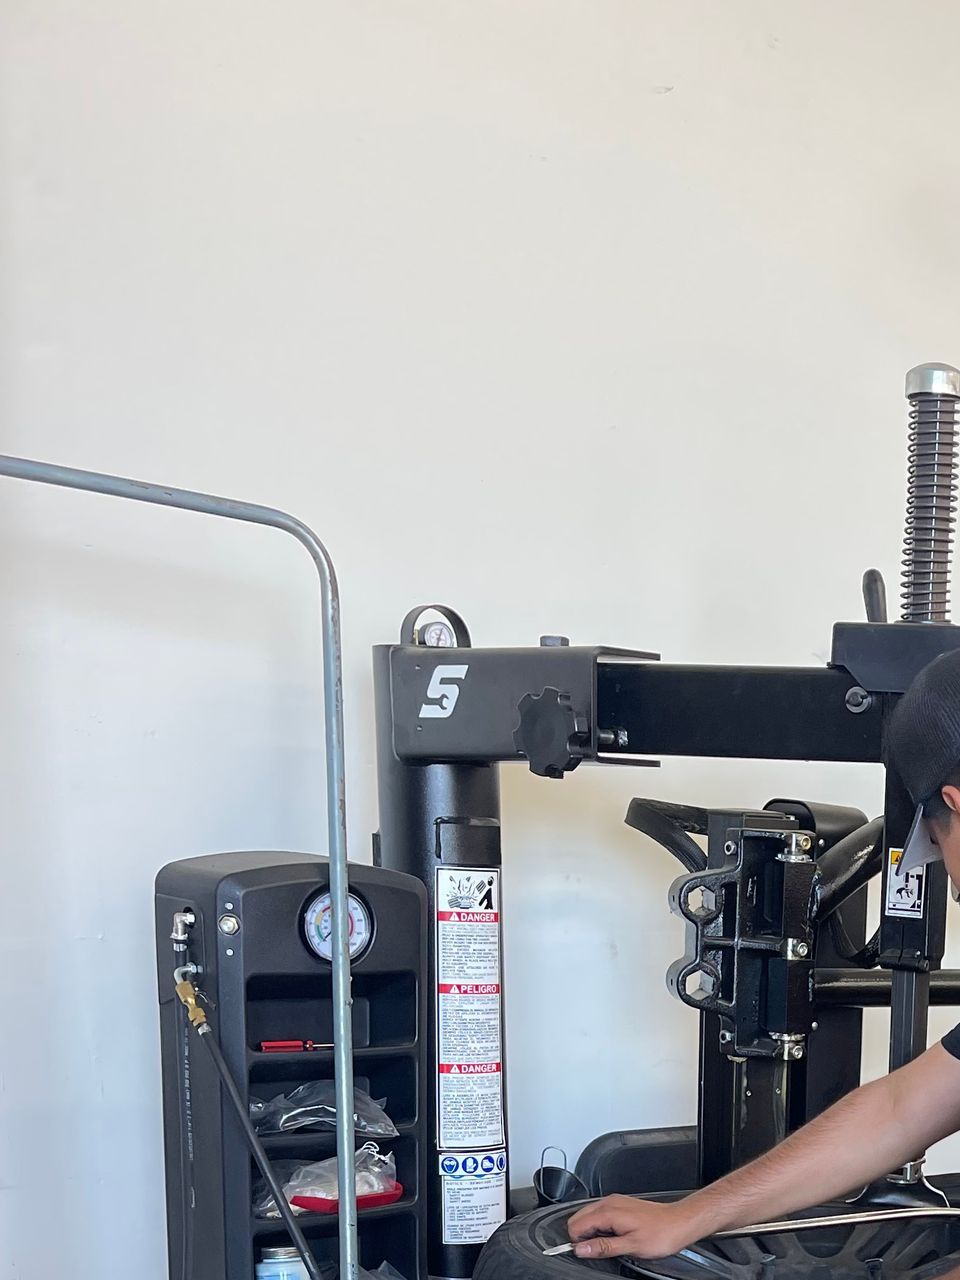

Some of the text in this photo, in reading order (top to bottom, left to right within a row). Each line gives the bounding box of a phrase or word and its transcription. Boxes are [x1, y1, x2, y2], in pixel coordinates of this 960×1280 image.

[460, 912, 496, 922] DANGER
[460, 984, 497, 994] PELIGRO
[461, 1063, 497, 1074] DANGER
